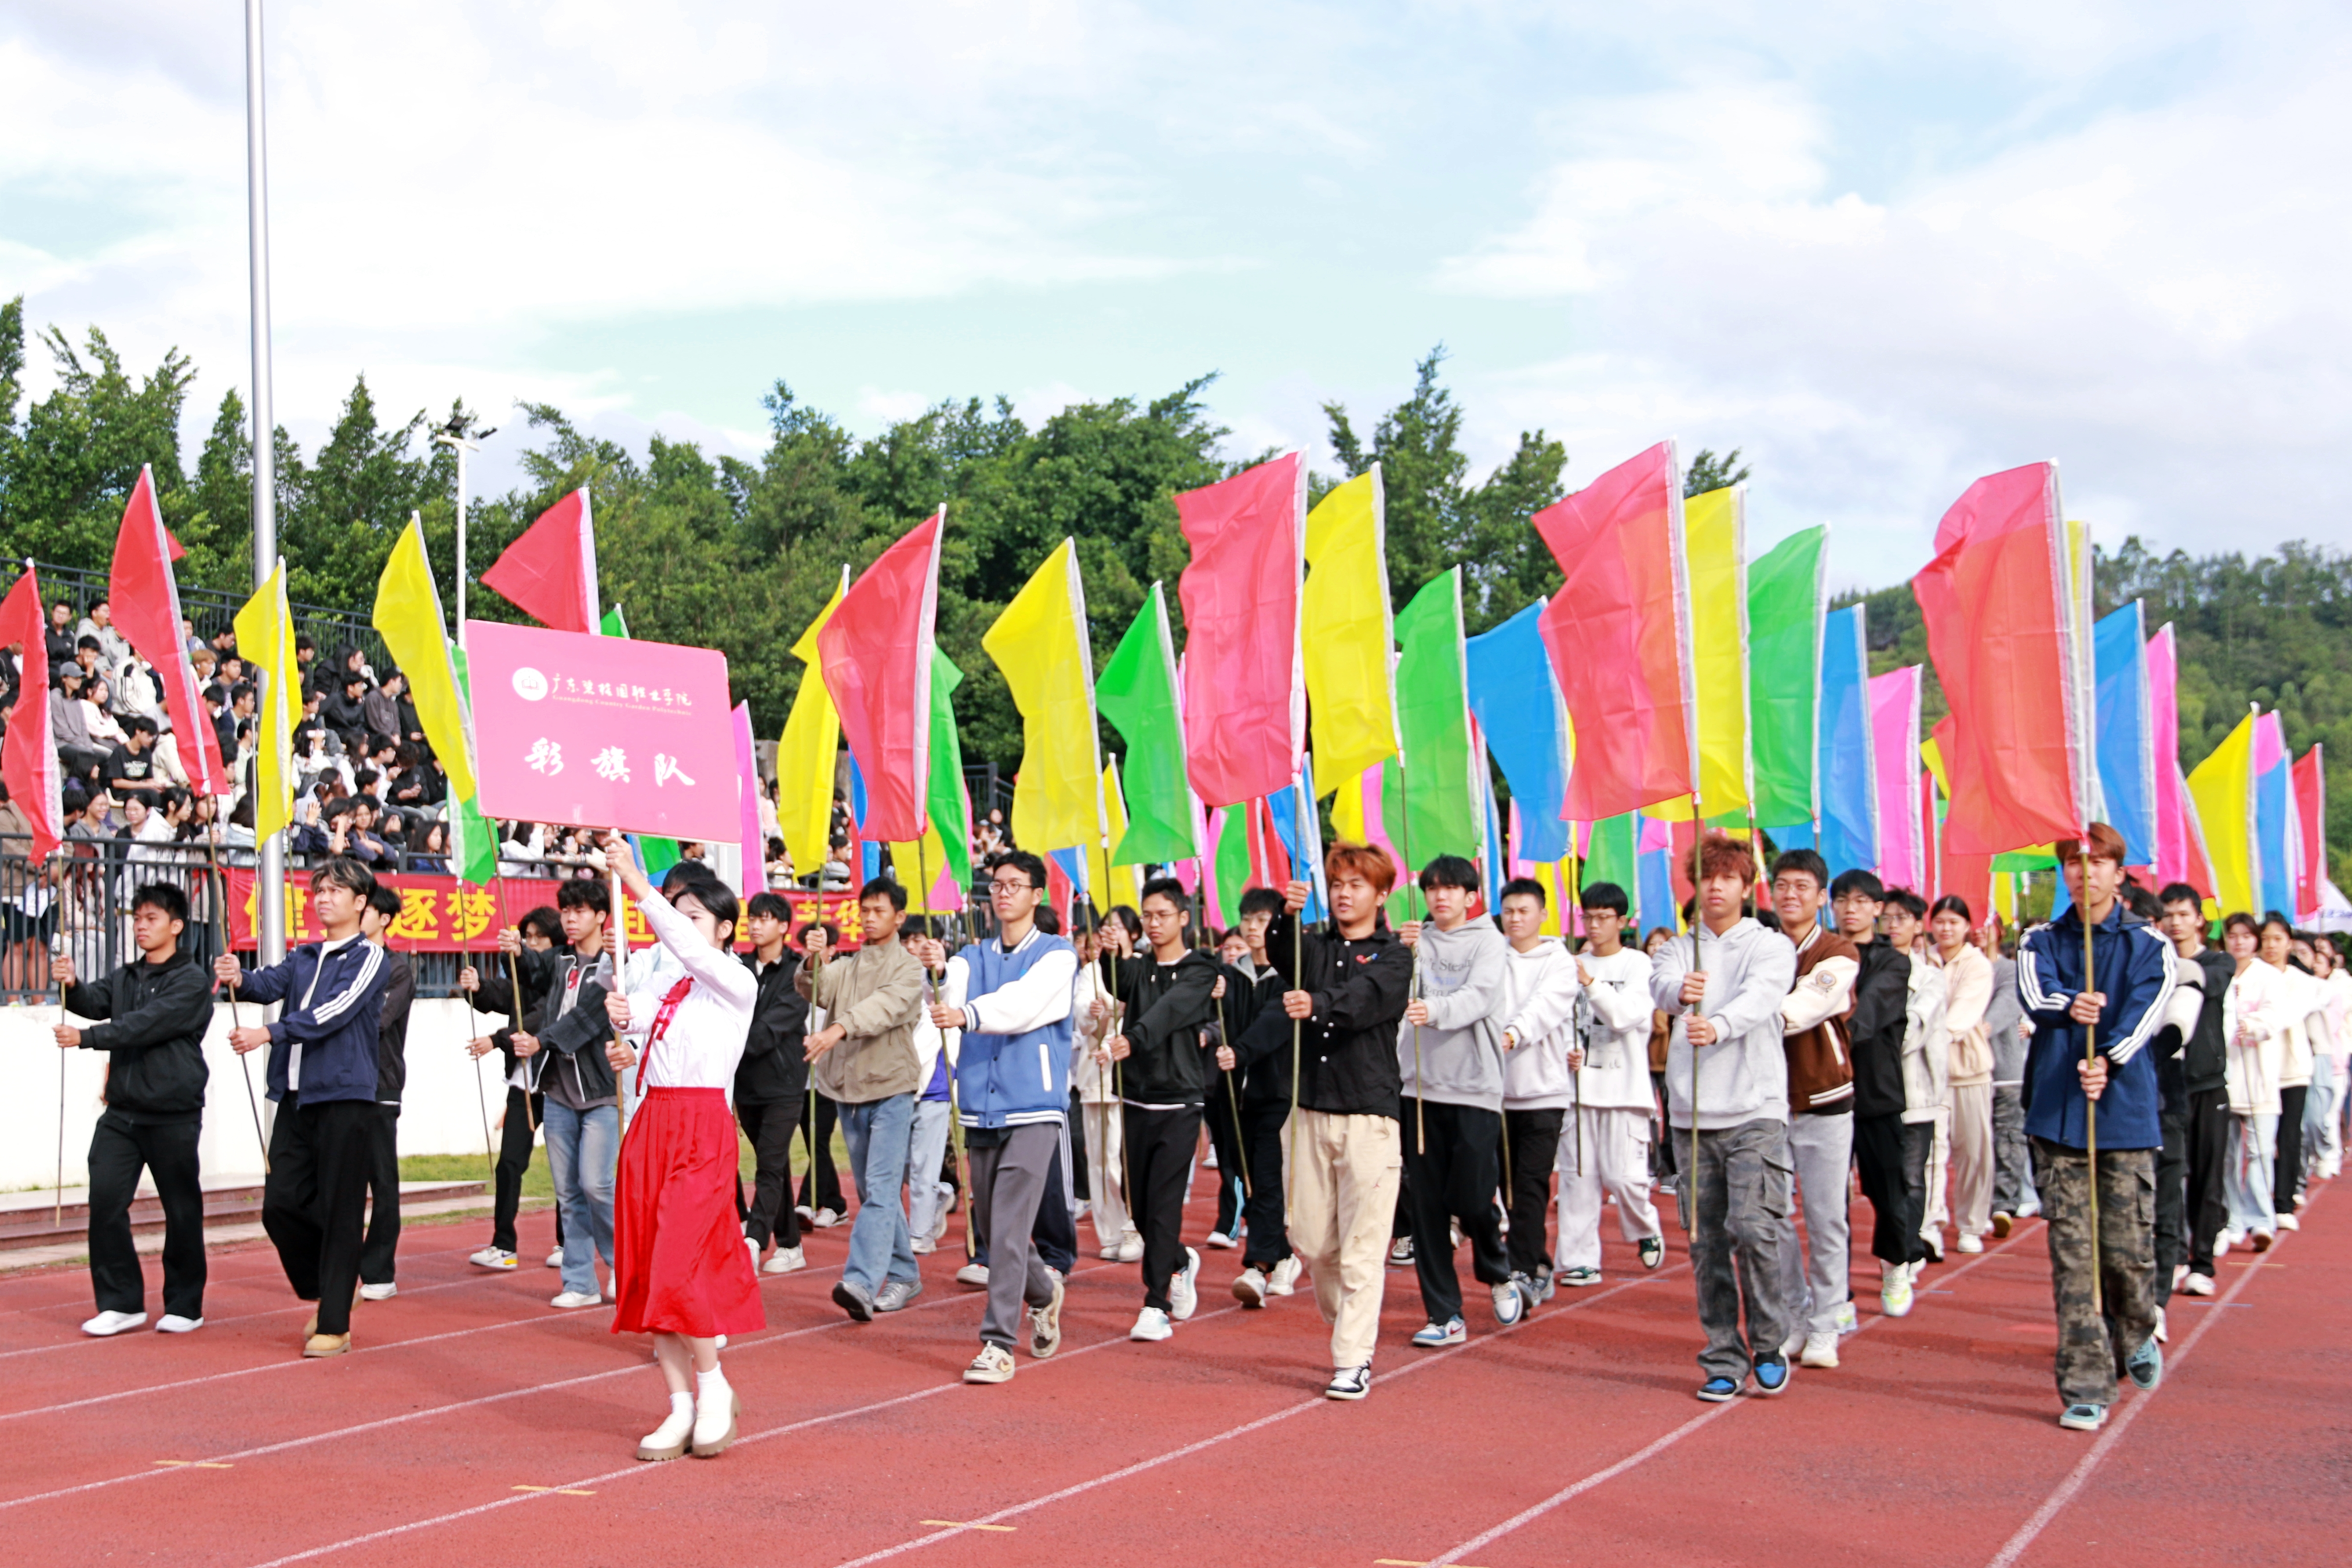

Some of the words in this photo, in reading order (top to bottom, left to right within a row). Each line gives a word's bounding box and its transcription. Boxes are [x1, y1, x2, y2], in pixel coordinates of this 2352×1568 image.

[552, 694, 593, 705] Guangdong
[595, 699, 623, 708] Country
[625, 702, 651, 711] Garden
[652, 706, 691, 716] Polytechnic
[524, 737, 695, 787] 彩旗队
